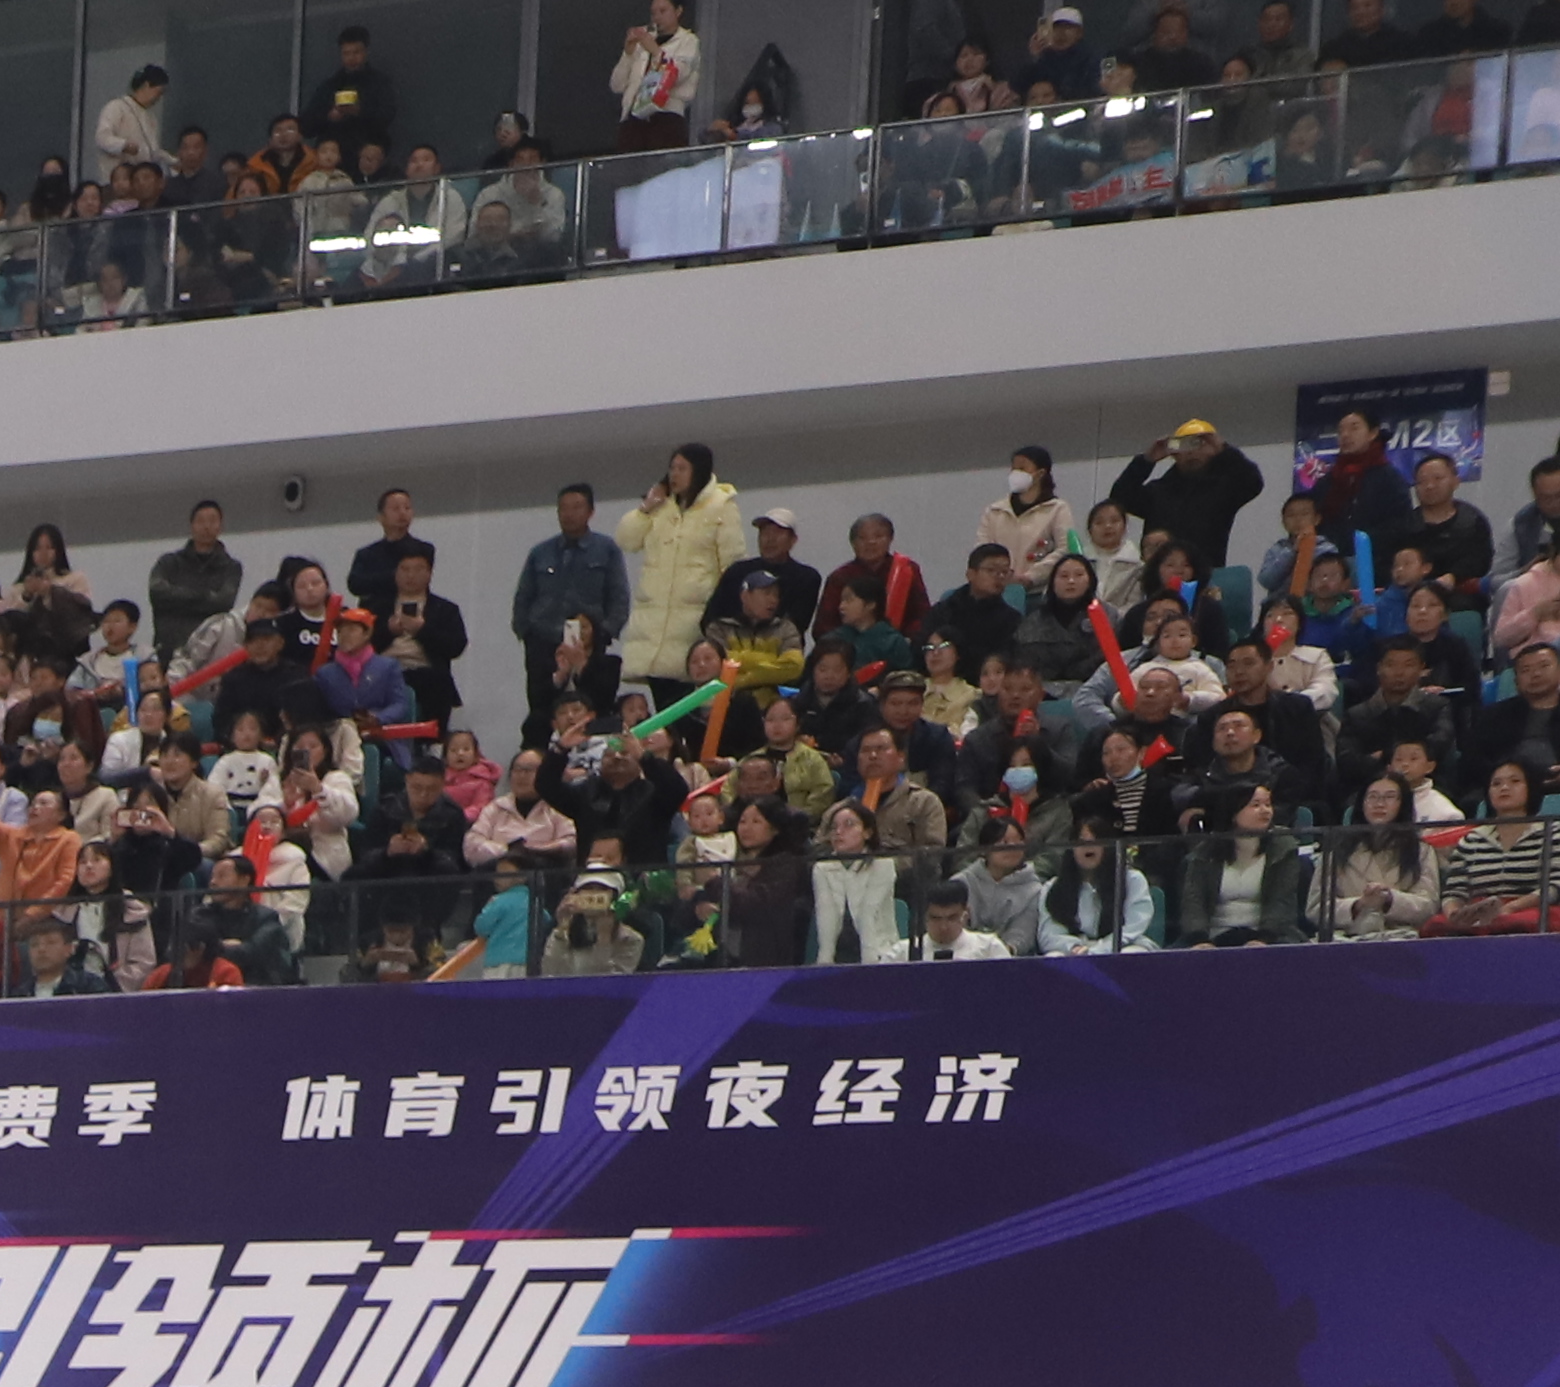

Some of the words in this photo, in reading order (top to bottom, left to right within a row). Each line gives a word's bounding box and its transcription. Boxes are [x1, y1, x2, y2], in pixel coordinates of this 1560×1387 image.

[1315, 418, 1462, 455] 二M2区
[282, 1053, 1019, 1139] 体育引领夜经济
